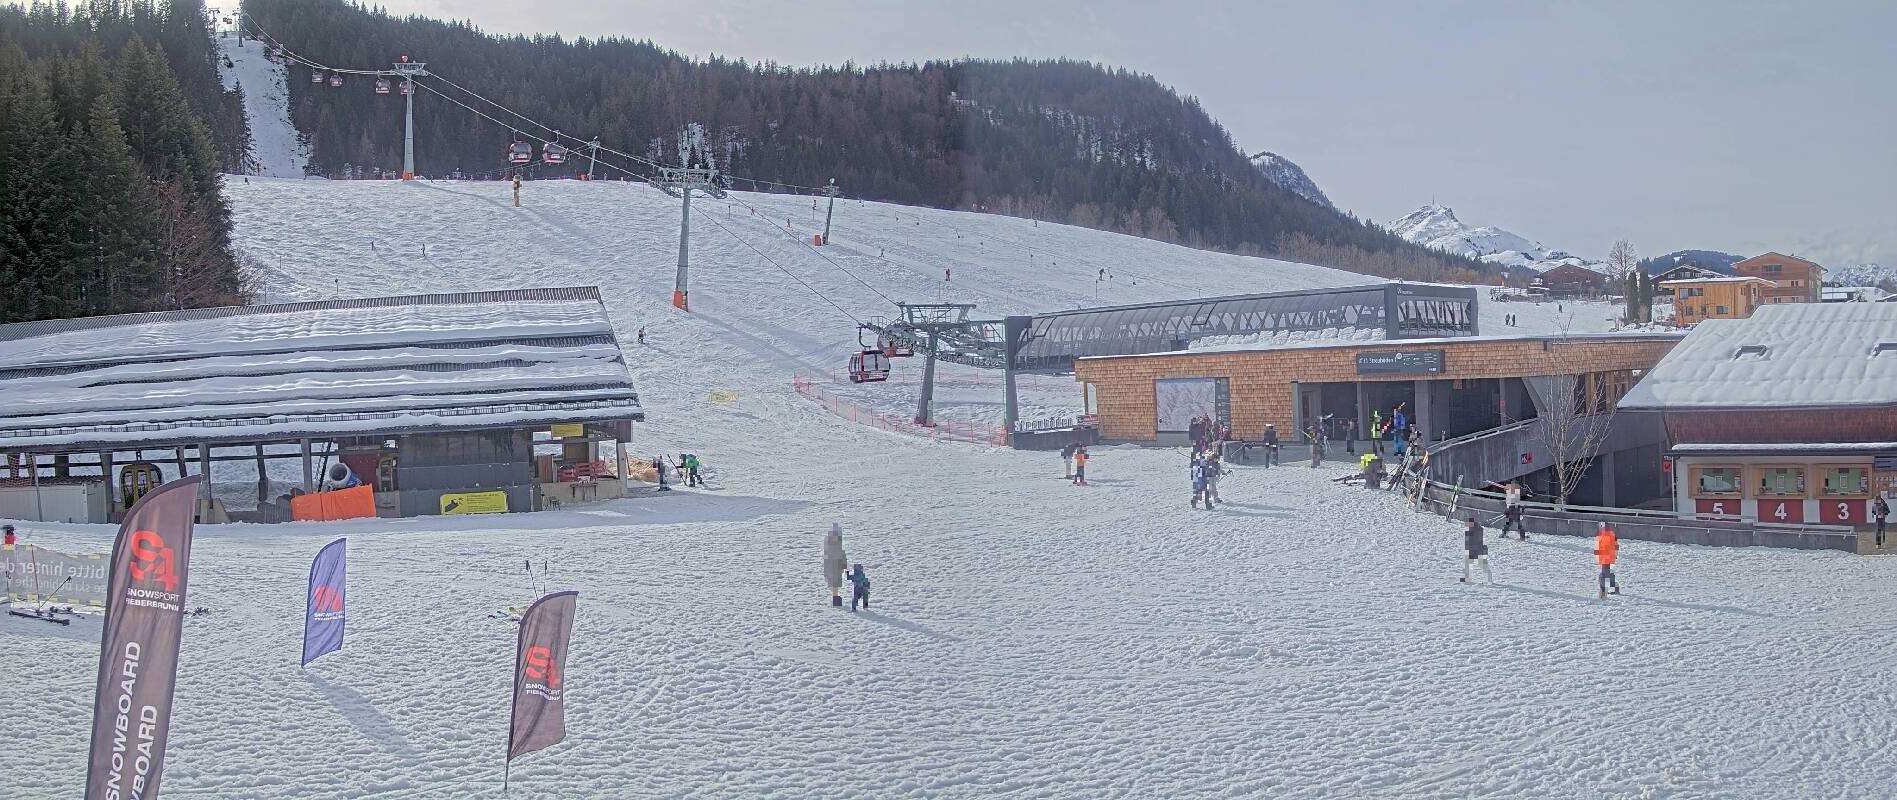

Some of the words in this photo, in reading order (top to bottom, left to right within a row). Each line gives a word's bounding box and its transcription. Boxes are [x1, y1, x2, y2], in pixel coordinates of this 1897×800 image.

[1712, 502, 1724, 519] 5
[1774, 502, 1787, 520] 4
[1837, 502, 1849, 520] 3
[130, 530, 180, 592] S4
[127, 588, 181, 602] SNOWSPORT
[105, 641, 141, 800] SNOWBOARD
